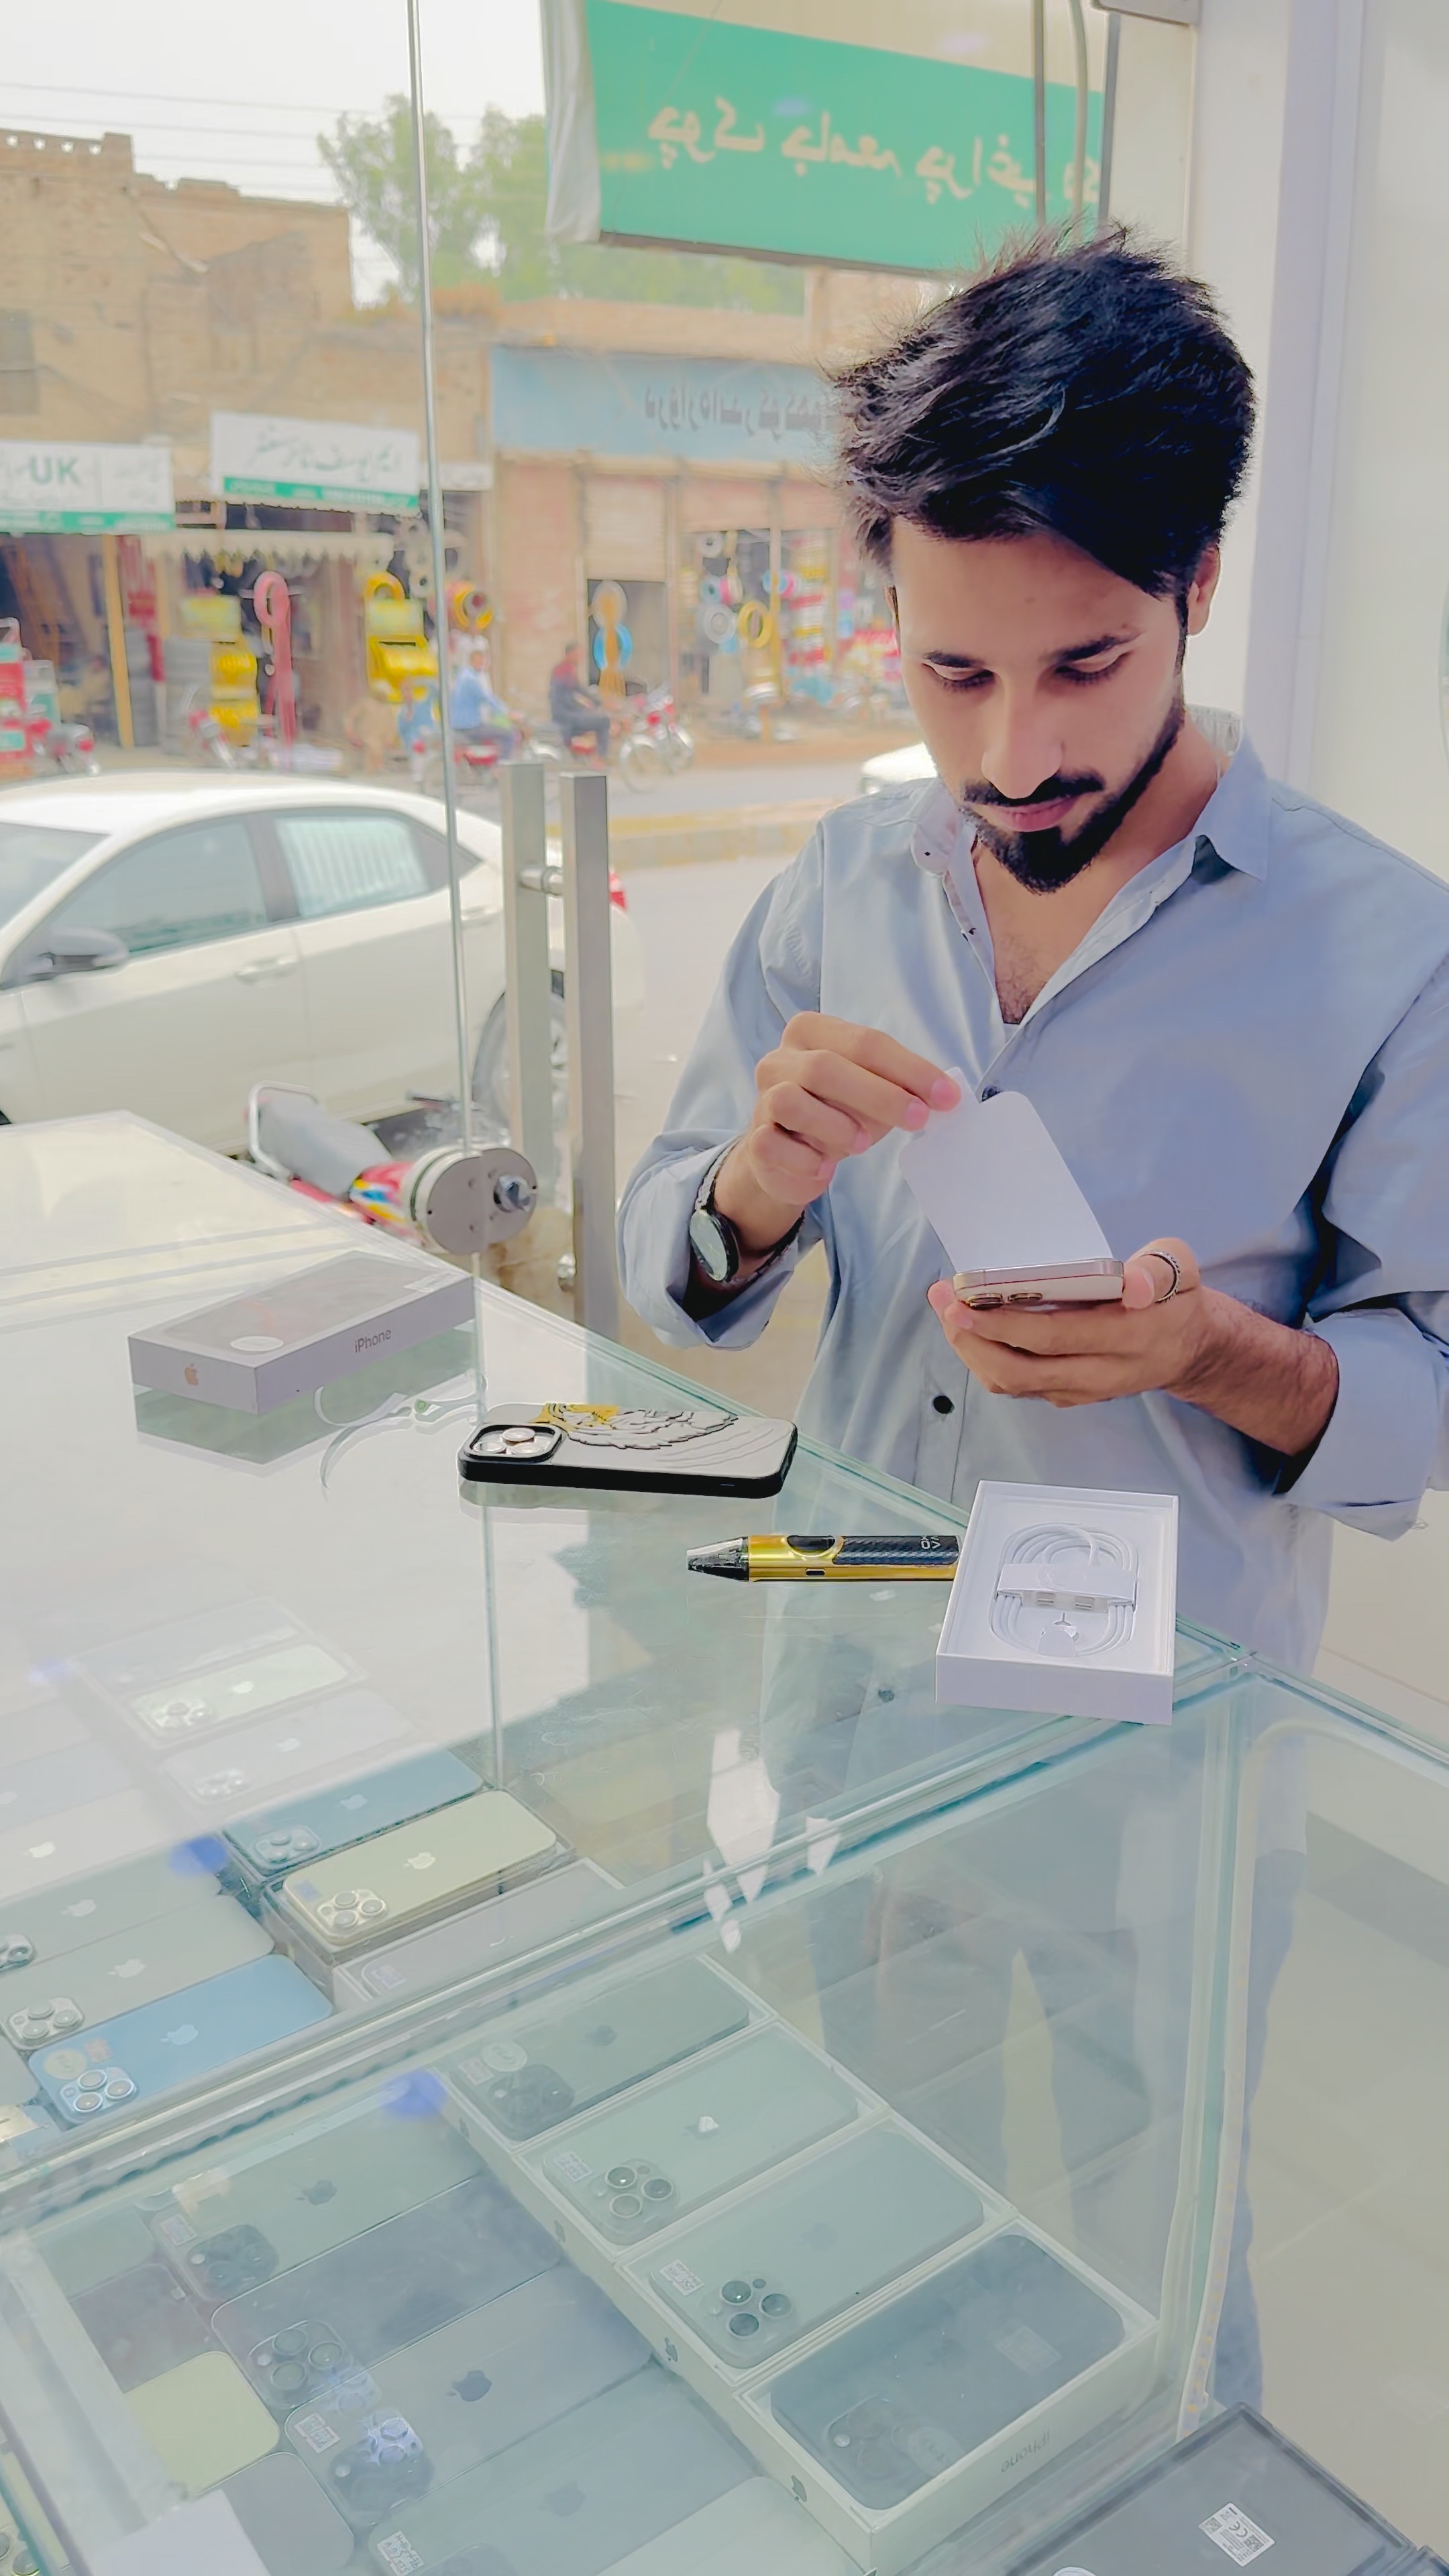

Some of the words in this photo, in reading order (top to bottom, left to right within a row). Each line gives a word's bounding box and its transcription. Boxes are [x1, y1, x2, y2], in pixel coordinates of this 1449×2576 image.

[30, 455, 81, 485] UK
[354, 1329, 392, 1354] iPhone
[1001, 2428, 1051, 2473] iPhone
